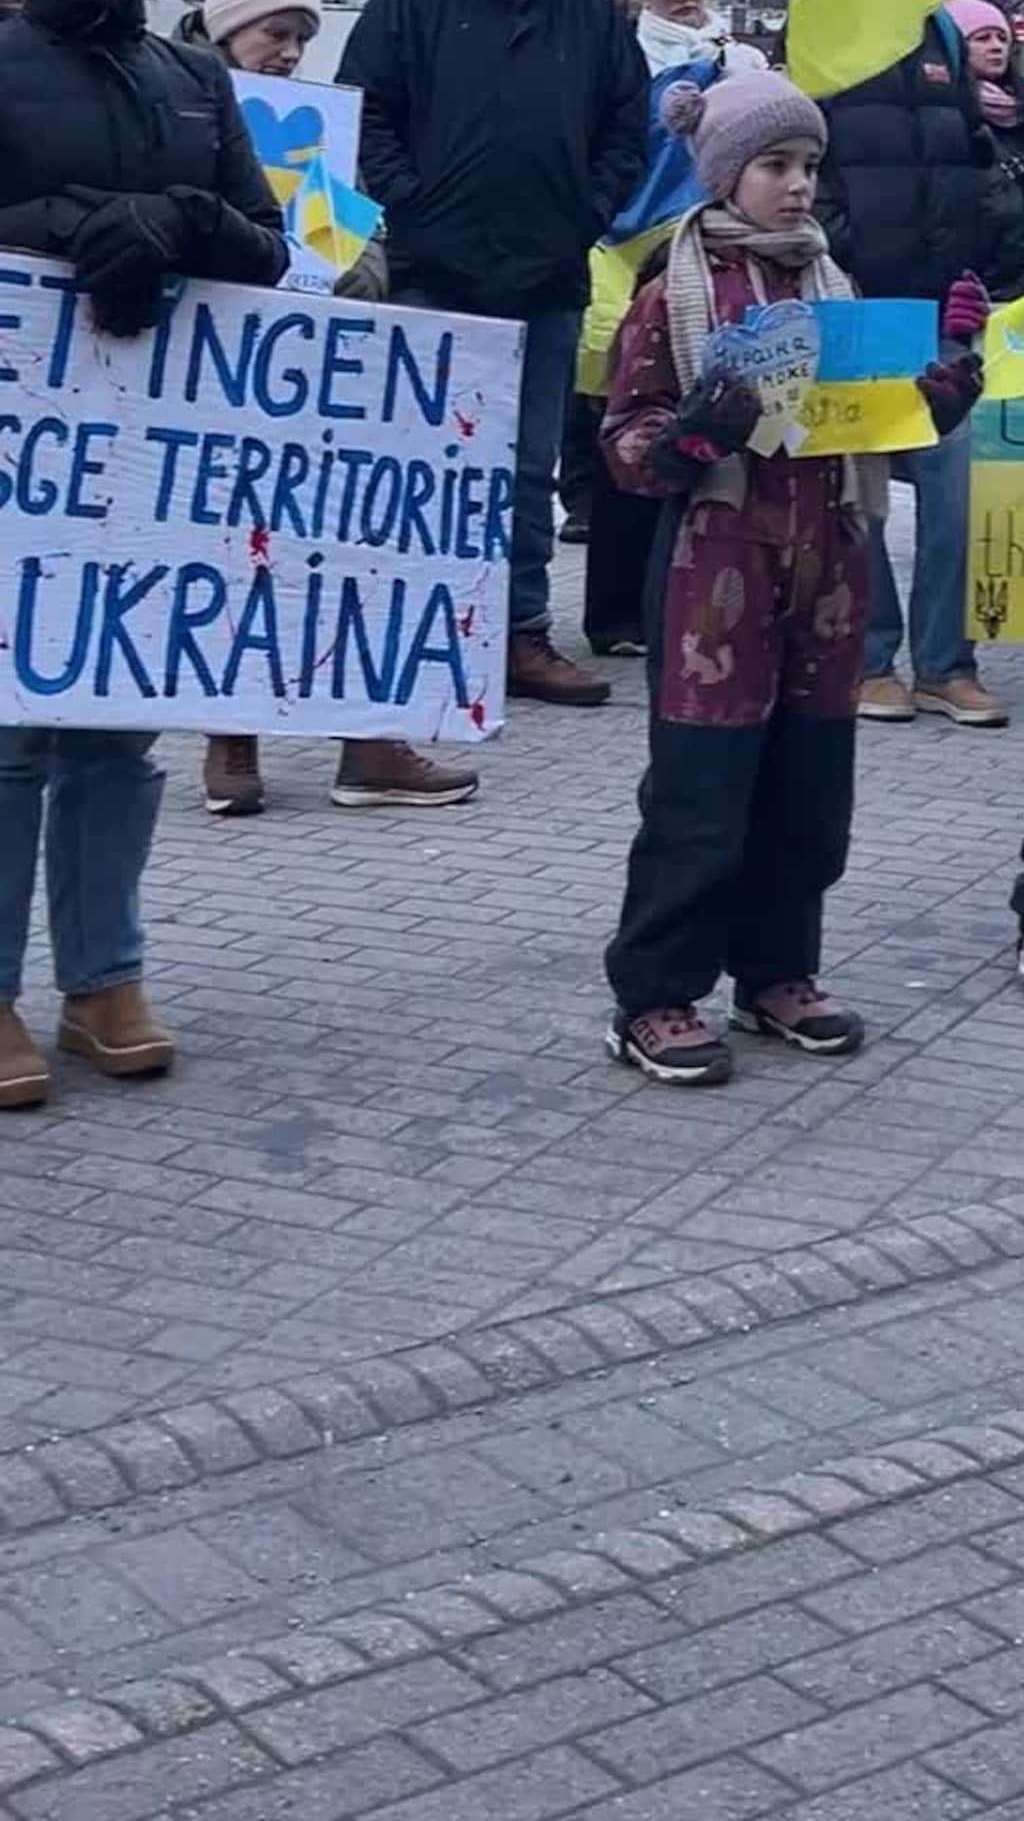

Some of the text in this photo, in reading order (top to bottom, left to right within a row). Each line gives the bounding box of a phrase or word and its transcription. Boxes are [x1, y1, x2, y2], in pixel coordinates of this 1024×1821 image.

[148, 286, 453, 426] INGEN
[144, 426, 513, 562] TERRITORIER
[15, 553, 470, 708] UKRAINA
